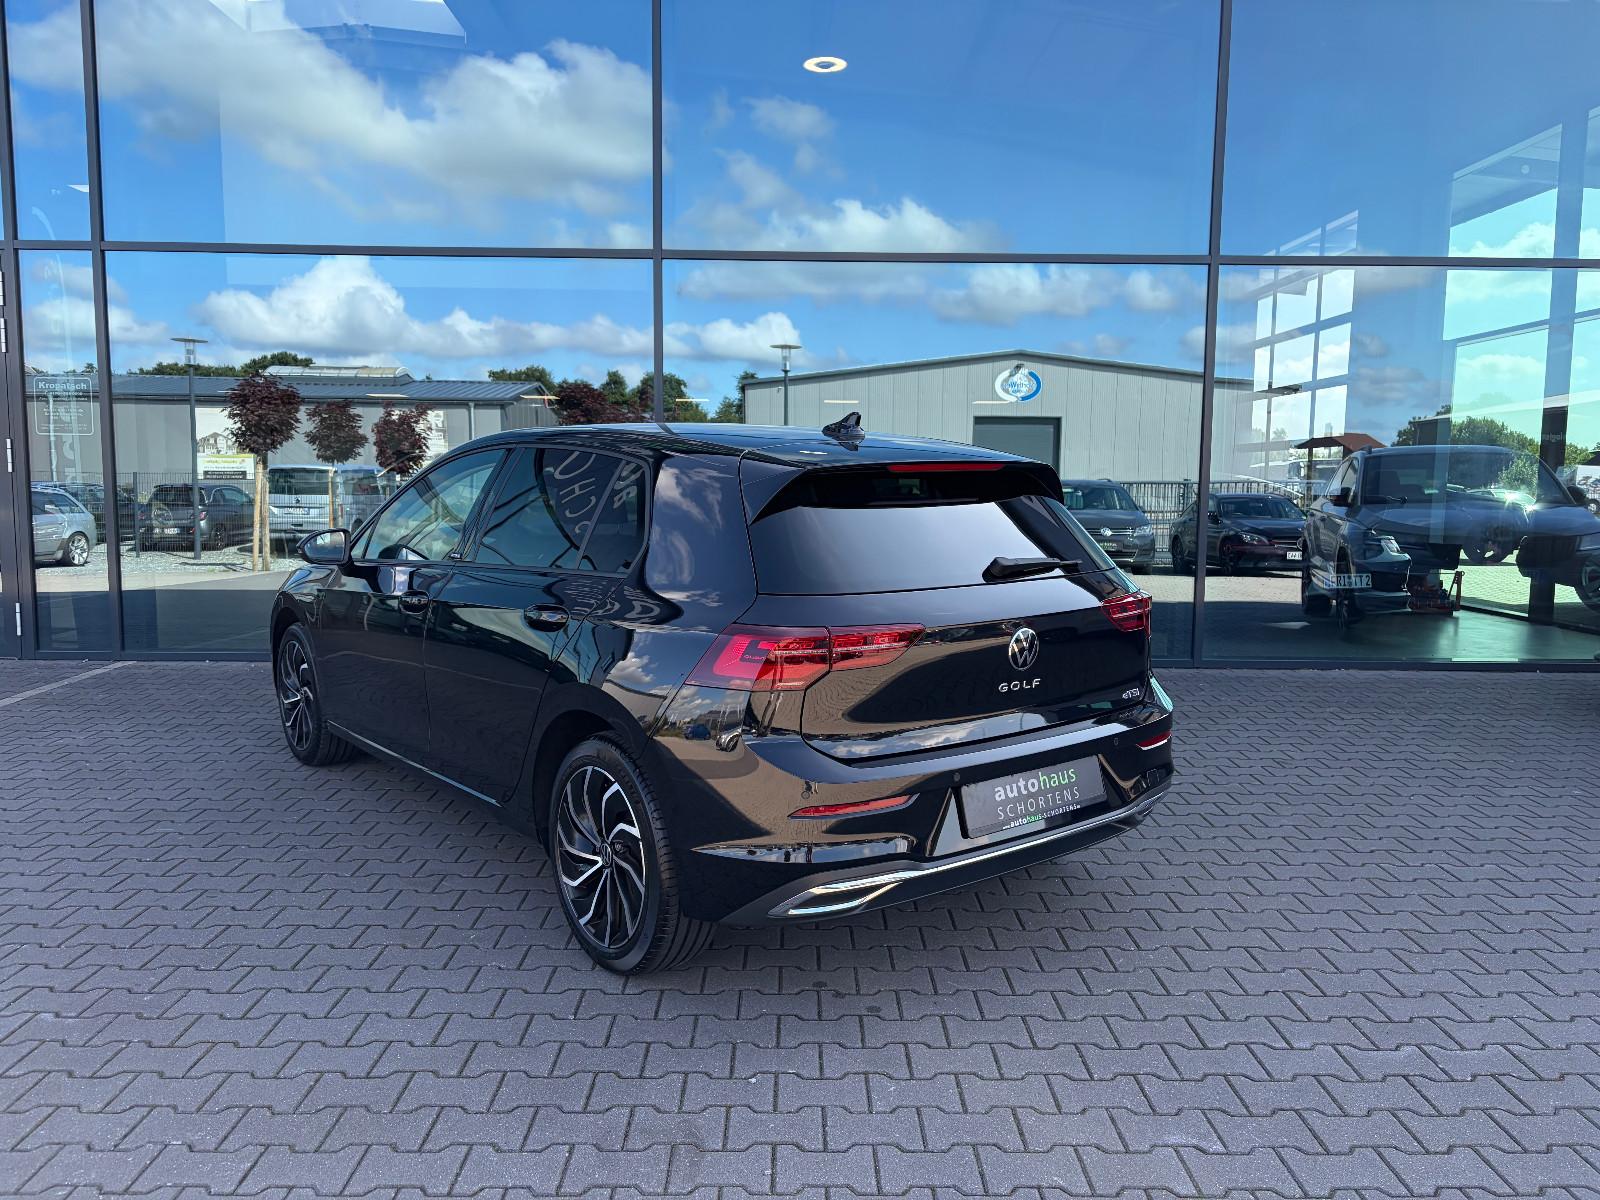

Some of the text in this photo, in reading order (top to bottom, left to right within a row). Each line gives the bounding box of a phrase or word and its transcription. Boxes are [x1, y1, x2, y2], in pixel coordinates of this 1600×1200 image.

[1008, 627, 1039, 671] VW
[998, 678, 1041, 692] GOLF
[994, 768, 1078, 801] autohaus
[997, 786, 1080, 820] SCHORTENS
